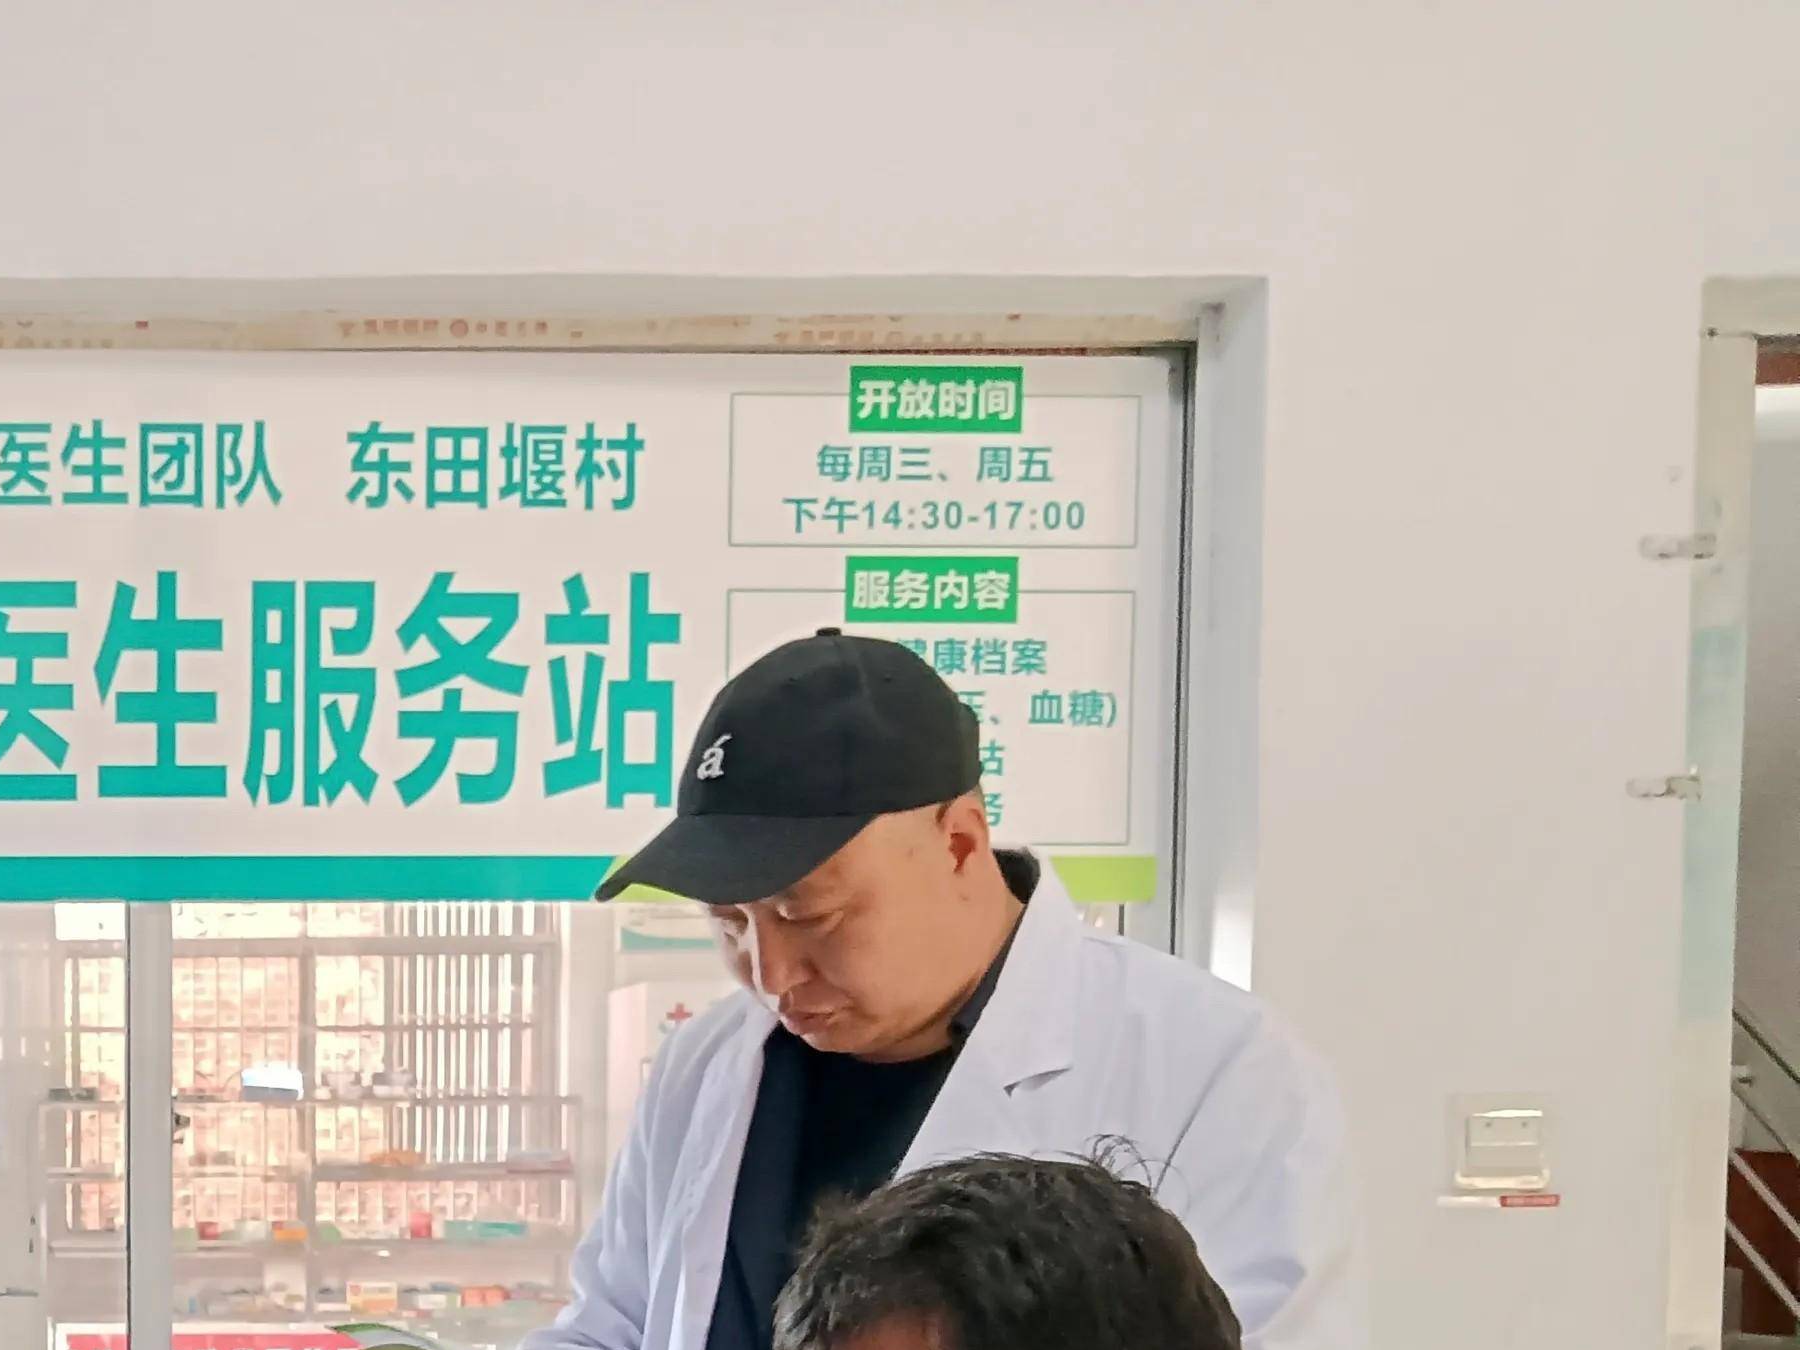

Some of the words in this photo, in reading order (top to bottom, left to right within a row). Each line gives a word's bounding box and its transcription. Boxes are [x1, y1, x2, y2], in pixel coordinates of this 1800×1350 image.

[856, 378, 1018, 421] 开放时间
[346, 421, 646, 511] 东田堰村
[816, 444, 1054, 484] 每周三、周五
[783, 497, 1086, 534] 下午14:30-17:00
[852, 569, 1012, 611] 服务内容
